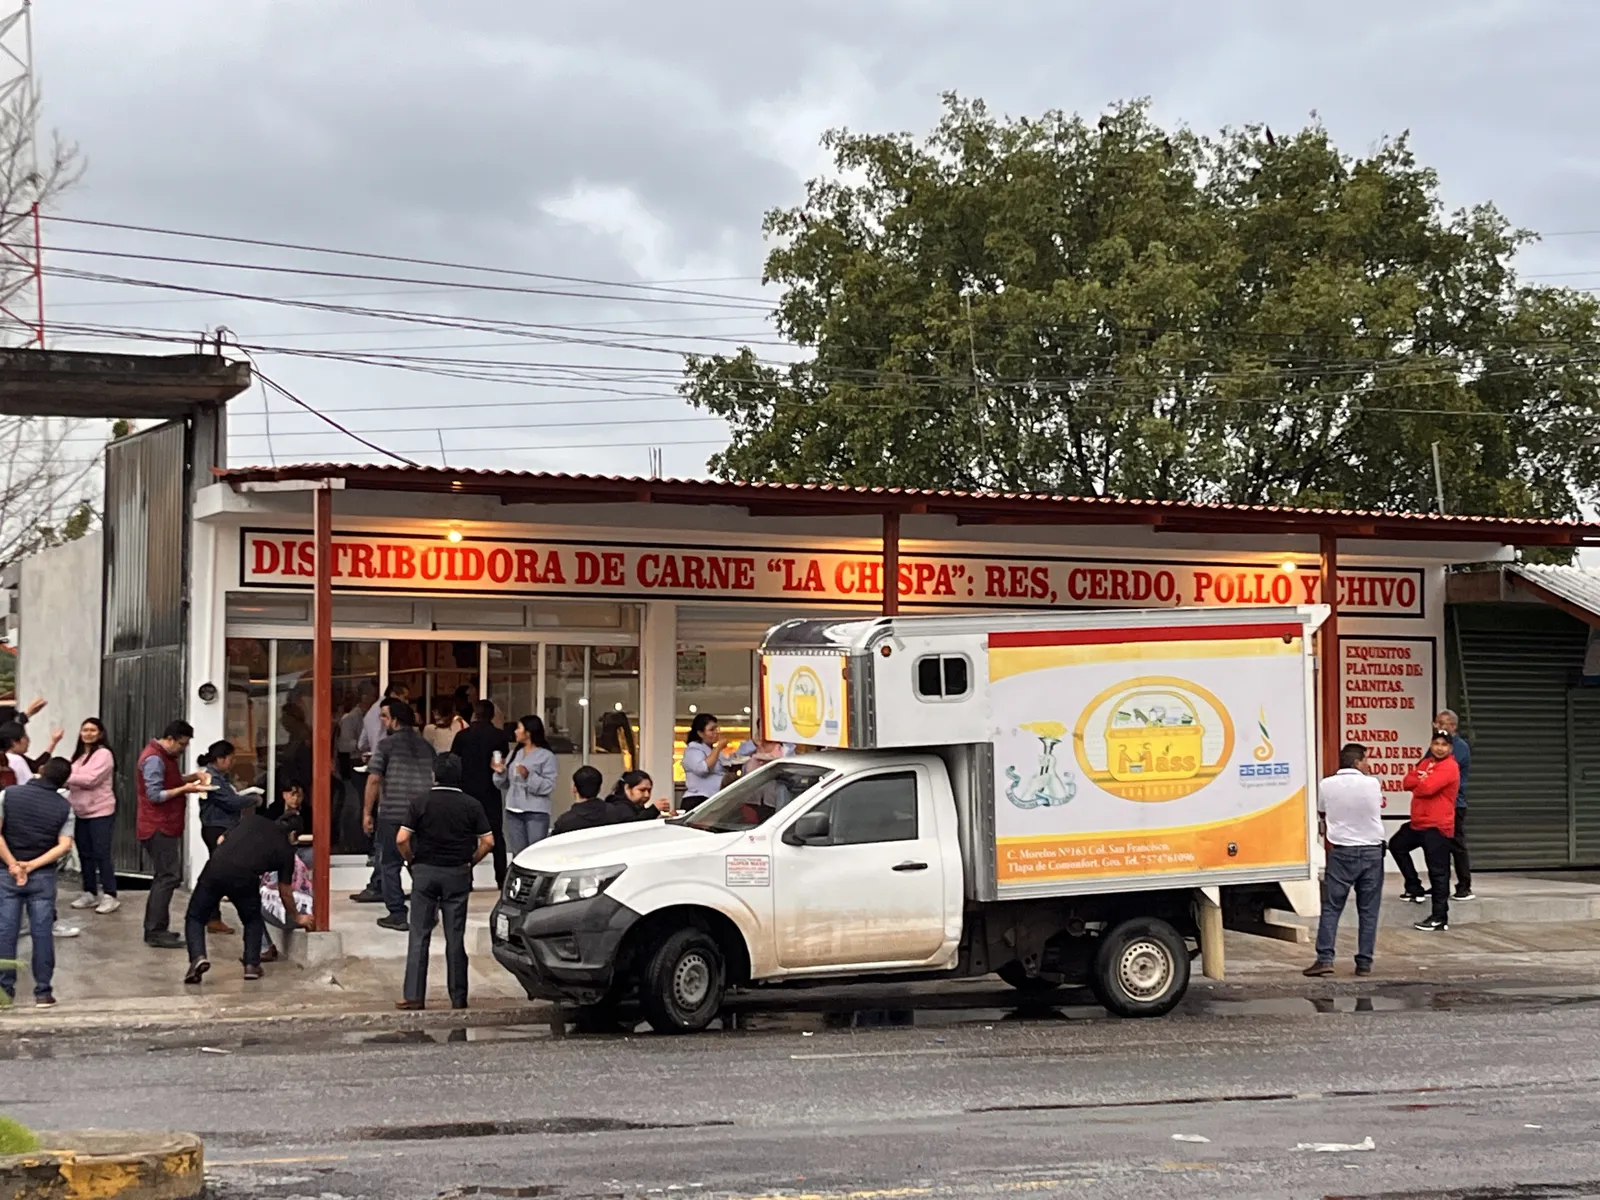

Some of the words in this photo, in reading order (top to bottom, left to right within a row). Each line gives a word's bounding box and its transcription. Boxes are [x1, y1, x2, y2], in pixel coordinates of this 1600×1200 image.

[252, 539, 565, 584] DISTRIBUIDORA
[575, 551, 624, 586] DE
[637, 554, 754, 589] CARNE
[834, 561, 974, 597] CHSPA”:
[985, 565, 1057, 603] RES,
[1068, 567, 1182, 604] CERDO,
[1193, 571, 1292, 605] POLLO
[1300, 575, 1319, 604] Y
[1345, 645, 1411, 660] EXQUISITOS
[1345, 662, 1404, 676] PLATILLOS
[1345, 696, 1398, 709] MIXIOTES
[1399, 697, 1415, 709] DE
[1345, 712, 1367, 726] RES
[1345, 729, 1398, 743] CARNERO
[1385, 746, 1399, 759] DE
[1401, 746, 1422, 759] RES
[1390, 763, 1405, 776] DE
[1019, 848, 1057, 859] Morelos
[1108, 844, 1125, 853] San
[1008, 862, 1034, 875] Tlapa
[1035, 861, 1046, 871] de
